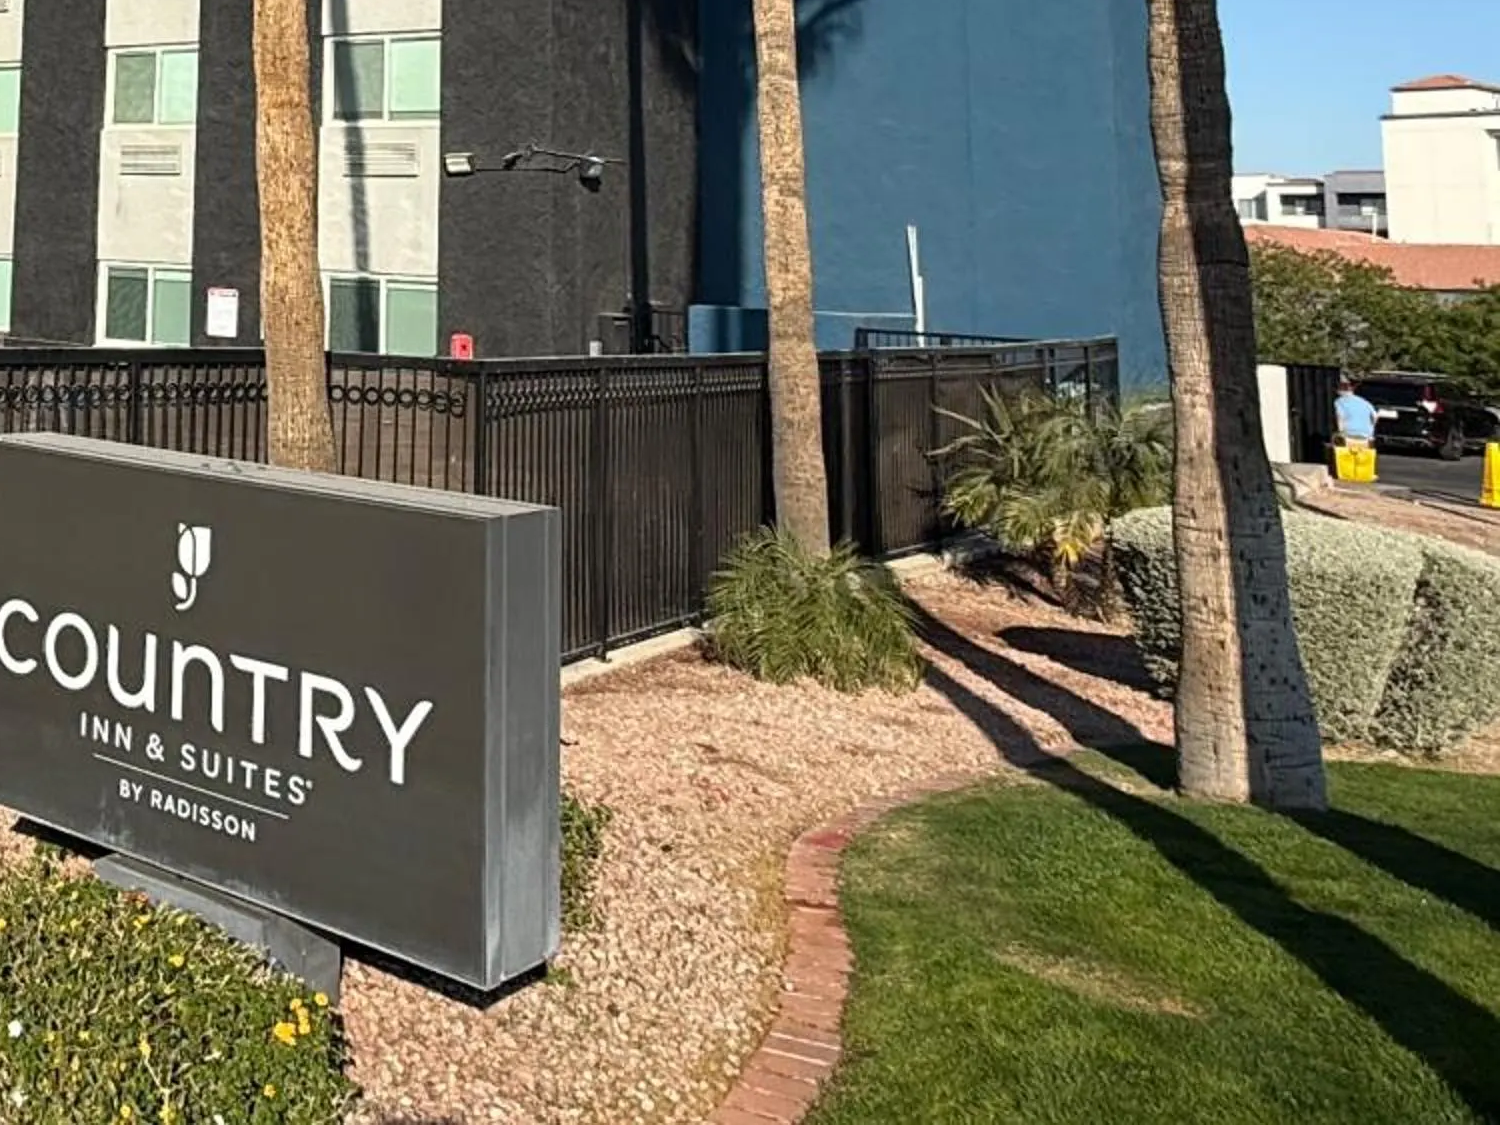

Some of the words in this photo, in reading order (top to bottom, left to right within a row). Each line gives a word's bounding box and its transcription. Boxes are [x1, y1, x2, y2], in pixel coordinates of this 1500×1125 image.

[78, 711, 133, 753] INN
[145, 732, 166, 763] &
[118, 778, 144, 803] BY
[150, 789, 257, 843] RADISSON
